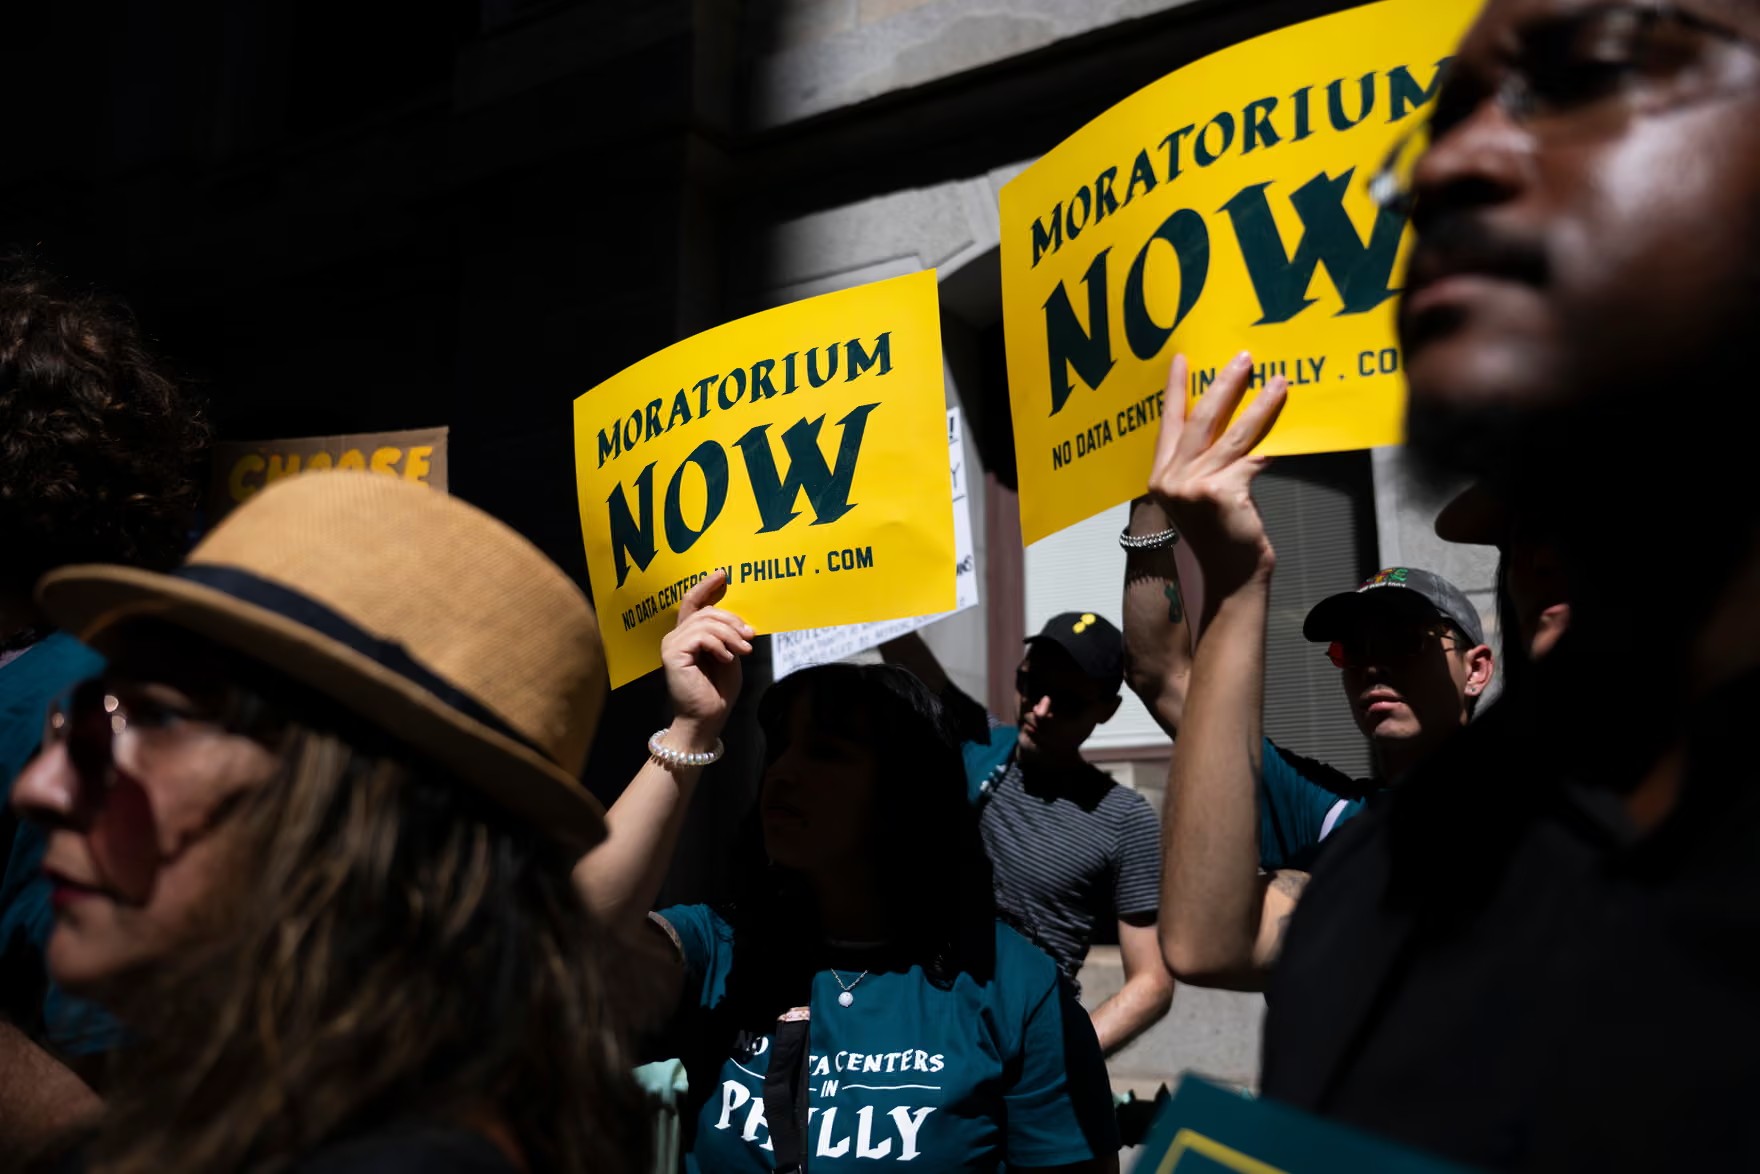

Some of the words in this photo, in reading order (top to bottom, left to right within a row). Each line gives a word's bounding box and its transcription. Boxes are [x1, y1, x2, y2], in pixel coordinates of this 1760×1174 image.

[1030, 56, 1456, 269] MORATORIUM
[1041, 166, 1408, 417] NOW
[597, 331, 893, 469] MORATORIUM
[1052, 440, 1072, 471] NO
[1076, 419, 1113, 458] DATA
[1116, 389, 1164, 437] CENTE
[1249, 356, 1326, 388] HILLY
[1358, 348, 1398, 377] CO
[605, 402, 882, 589] NOW
[621, 609, 636, 631] NO
[636, 595, 659, 624] DATA
[714, 565, 732, 586] N
[740, 554, 806, 584] PHILLY
[827, 546, 874, 572] COM
[714, 1080, 938, 1161] PHLLY
[820, 1079, 840, 1098] IN
[835, 1049, 945, 1073] CENTERS
